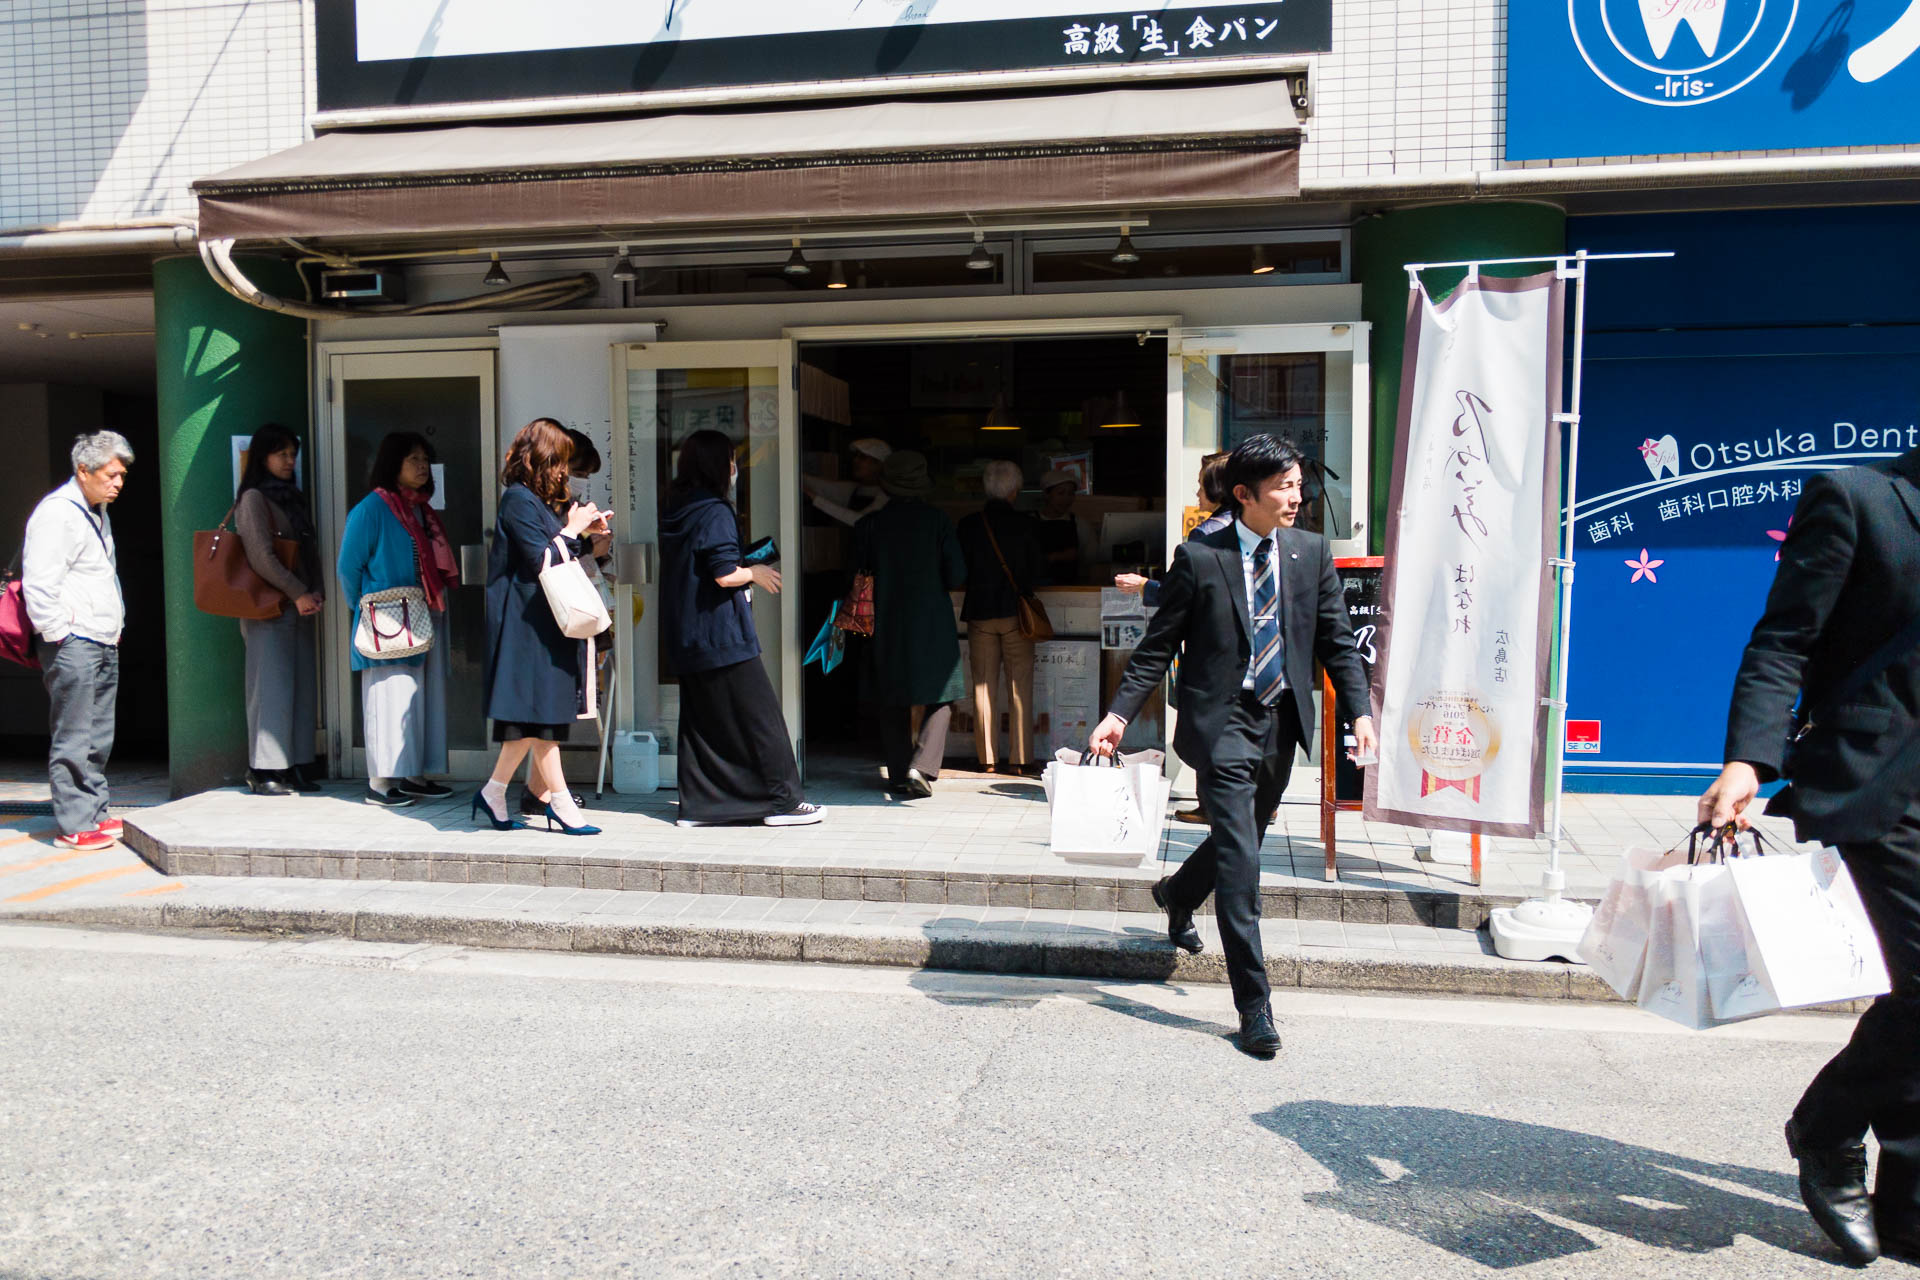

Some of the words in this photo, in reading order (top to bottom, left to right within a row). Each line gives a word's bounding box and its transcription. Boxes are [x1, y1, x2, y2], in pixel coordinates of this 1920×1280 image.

[1062, 15, 1279, 56] 高級「生」食パン
[1690, 428, 1816, 470] Otsuka
[1833, 422, 1919, 450] Dent
[1587, 511, 1635, 544] 歯科
[1657, 478, 1803, 523] 歯科口腔外科
[1567, 742, 1599, 751] SEOM
